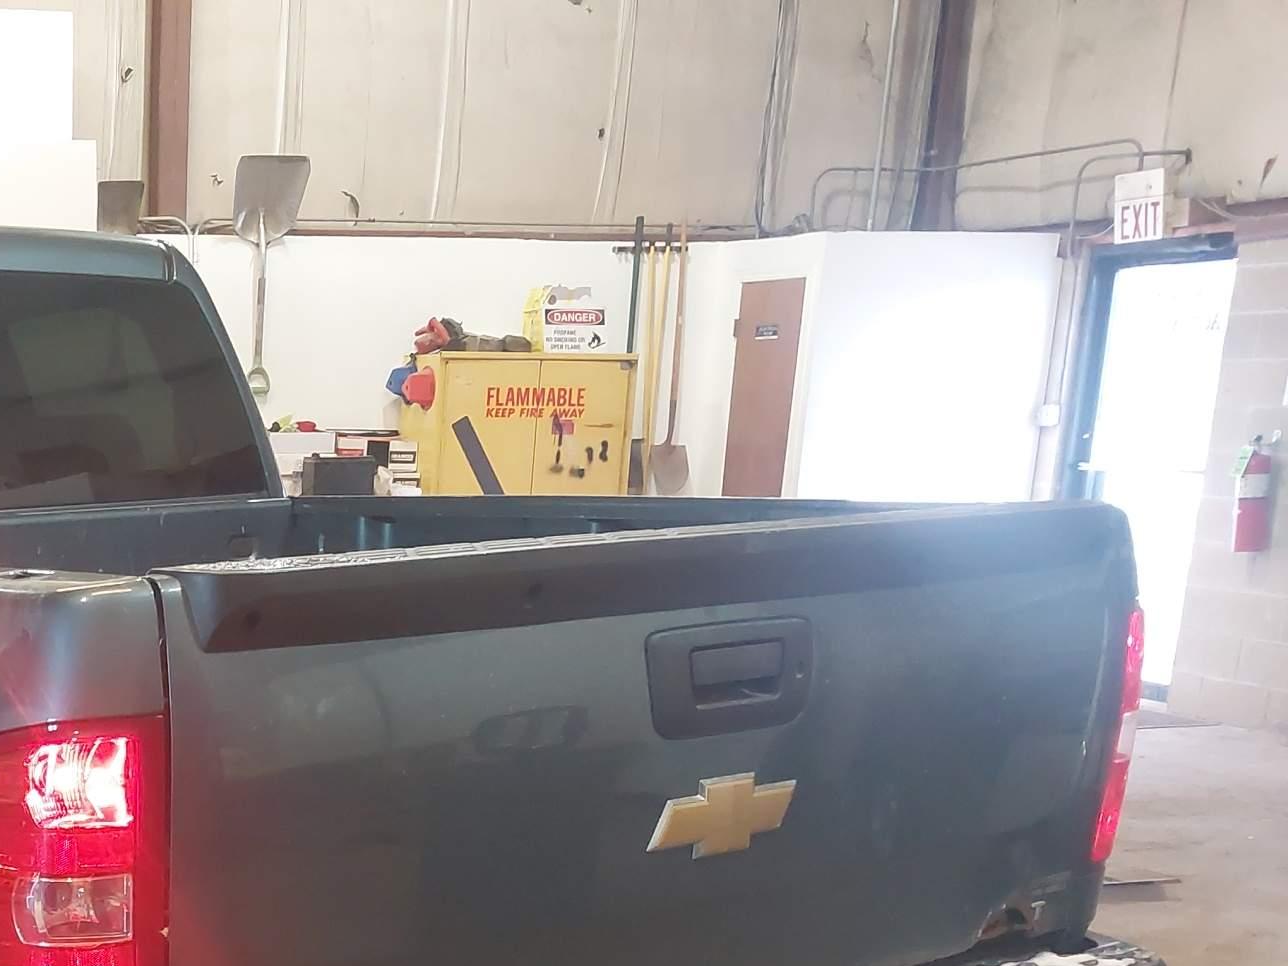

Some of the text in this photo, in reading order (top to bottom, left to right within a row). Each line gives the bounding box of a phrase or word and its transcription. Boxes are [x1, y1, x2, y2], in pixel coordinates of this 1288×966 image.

[1120, 201, 1161, 240] EXIT
[553, 312, 596, 322] DANGER
[486, 387, 586, 407] FLAMMABLE
[486, 407, 585, 418] KEEP FIRE AWAY
